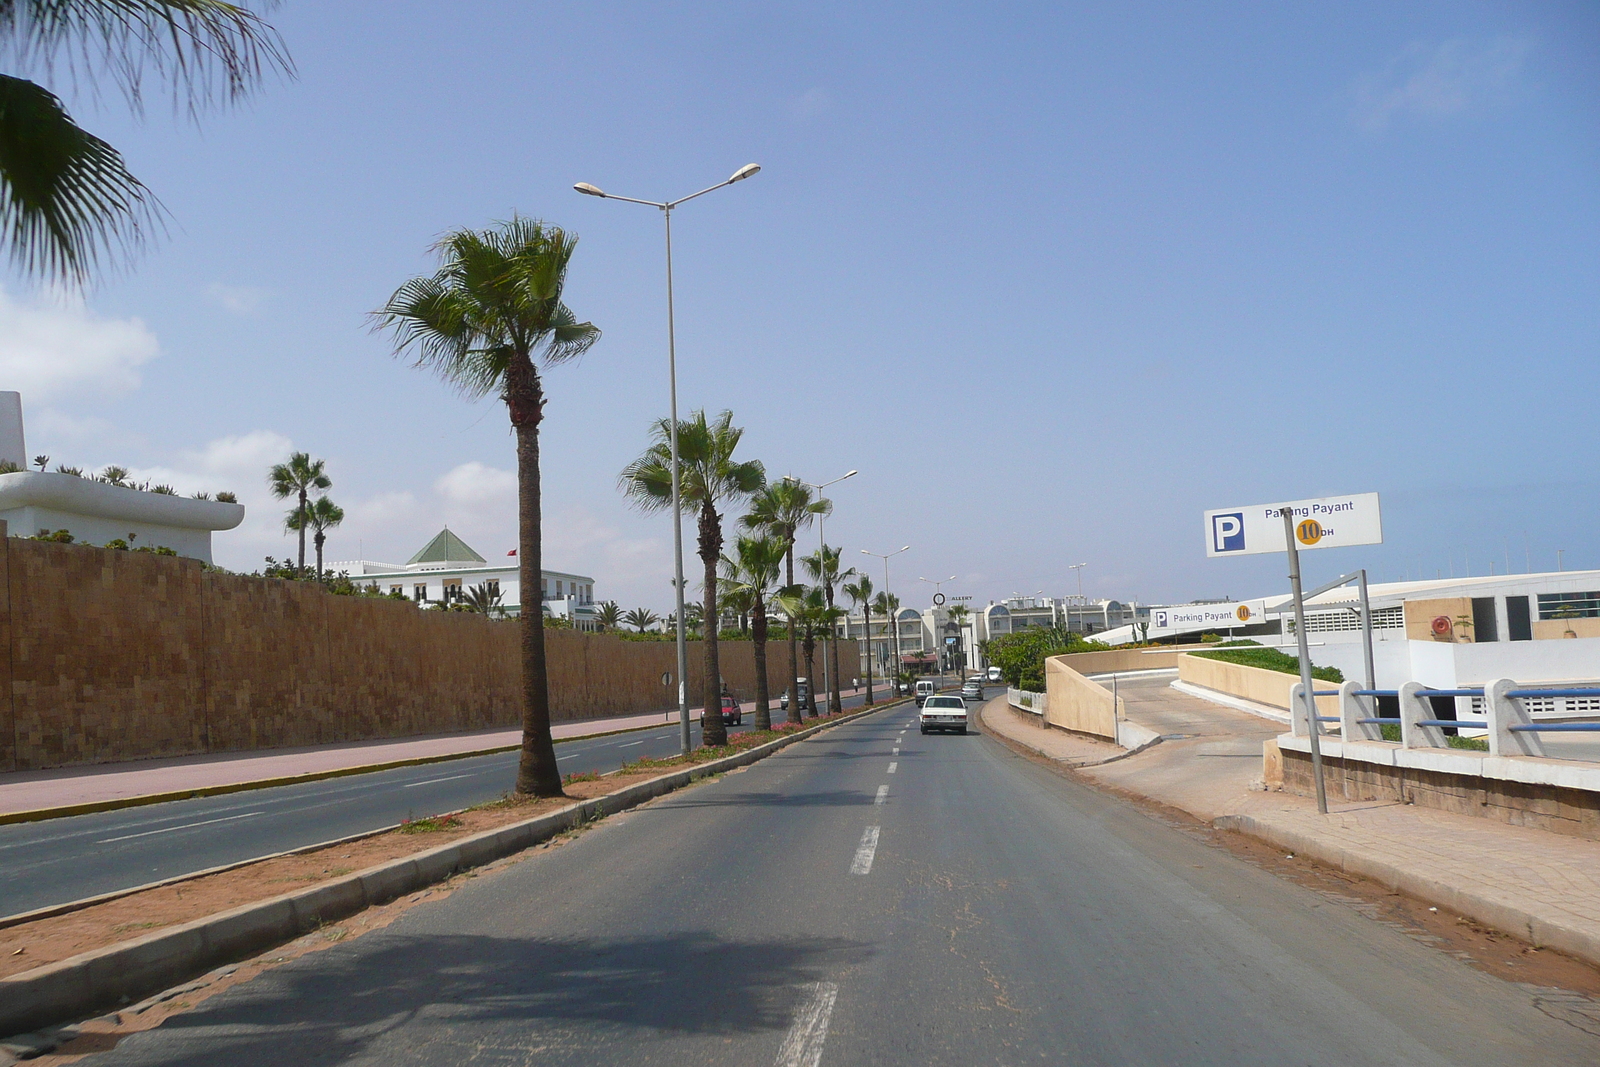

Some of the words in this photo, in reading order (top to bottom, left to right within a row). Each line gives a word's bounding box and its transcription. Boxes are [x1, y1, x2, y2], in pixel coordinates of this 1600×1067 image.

[1265, 507, 1309, 519] Paing
[1313, 501, 1354, 515] Payant
[1215, 516, 1241, 550] P
[1157, 612, 1166, 627] P
[1173, 613, 1202, 622] Parking
[1205, 611, 1232, 621] Payant
